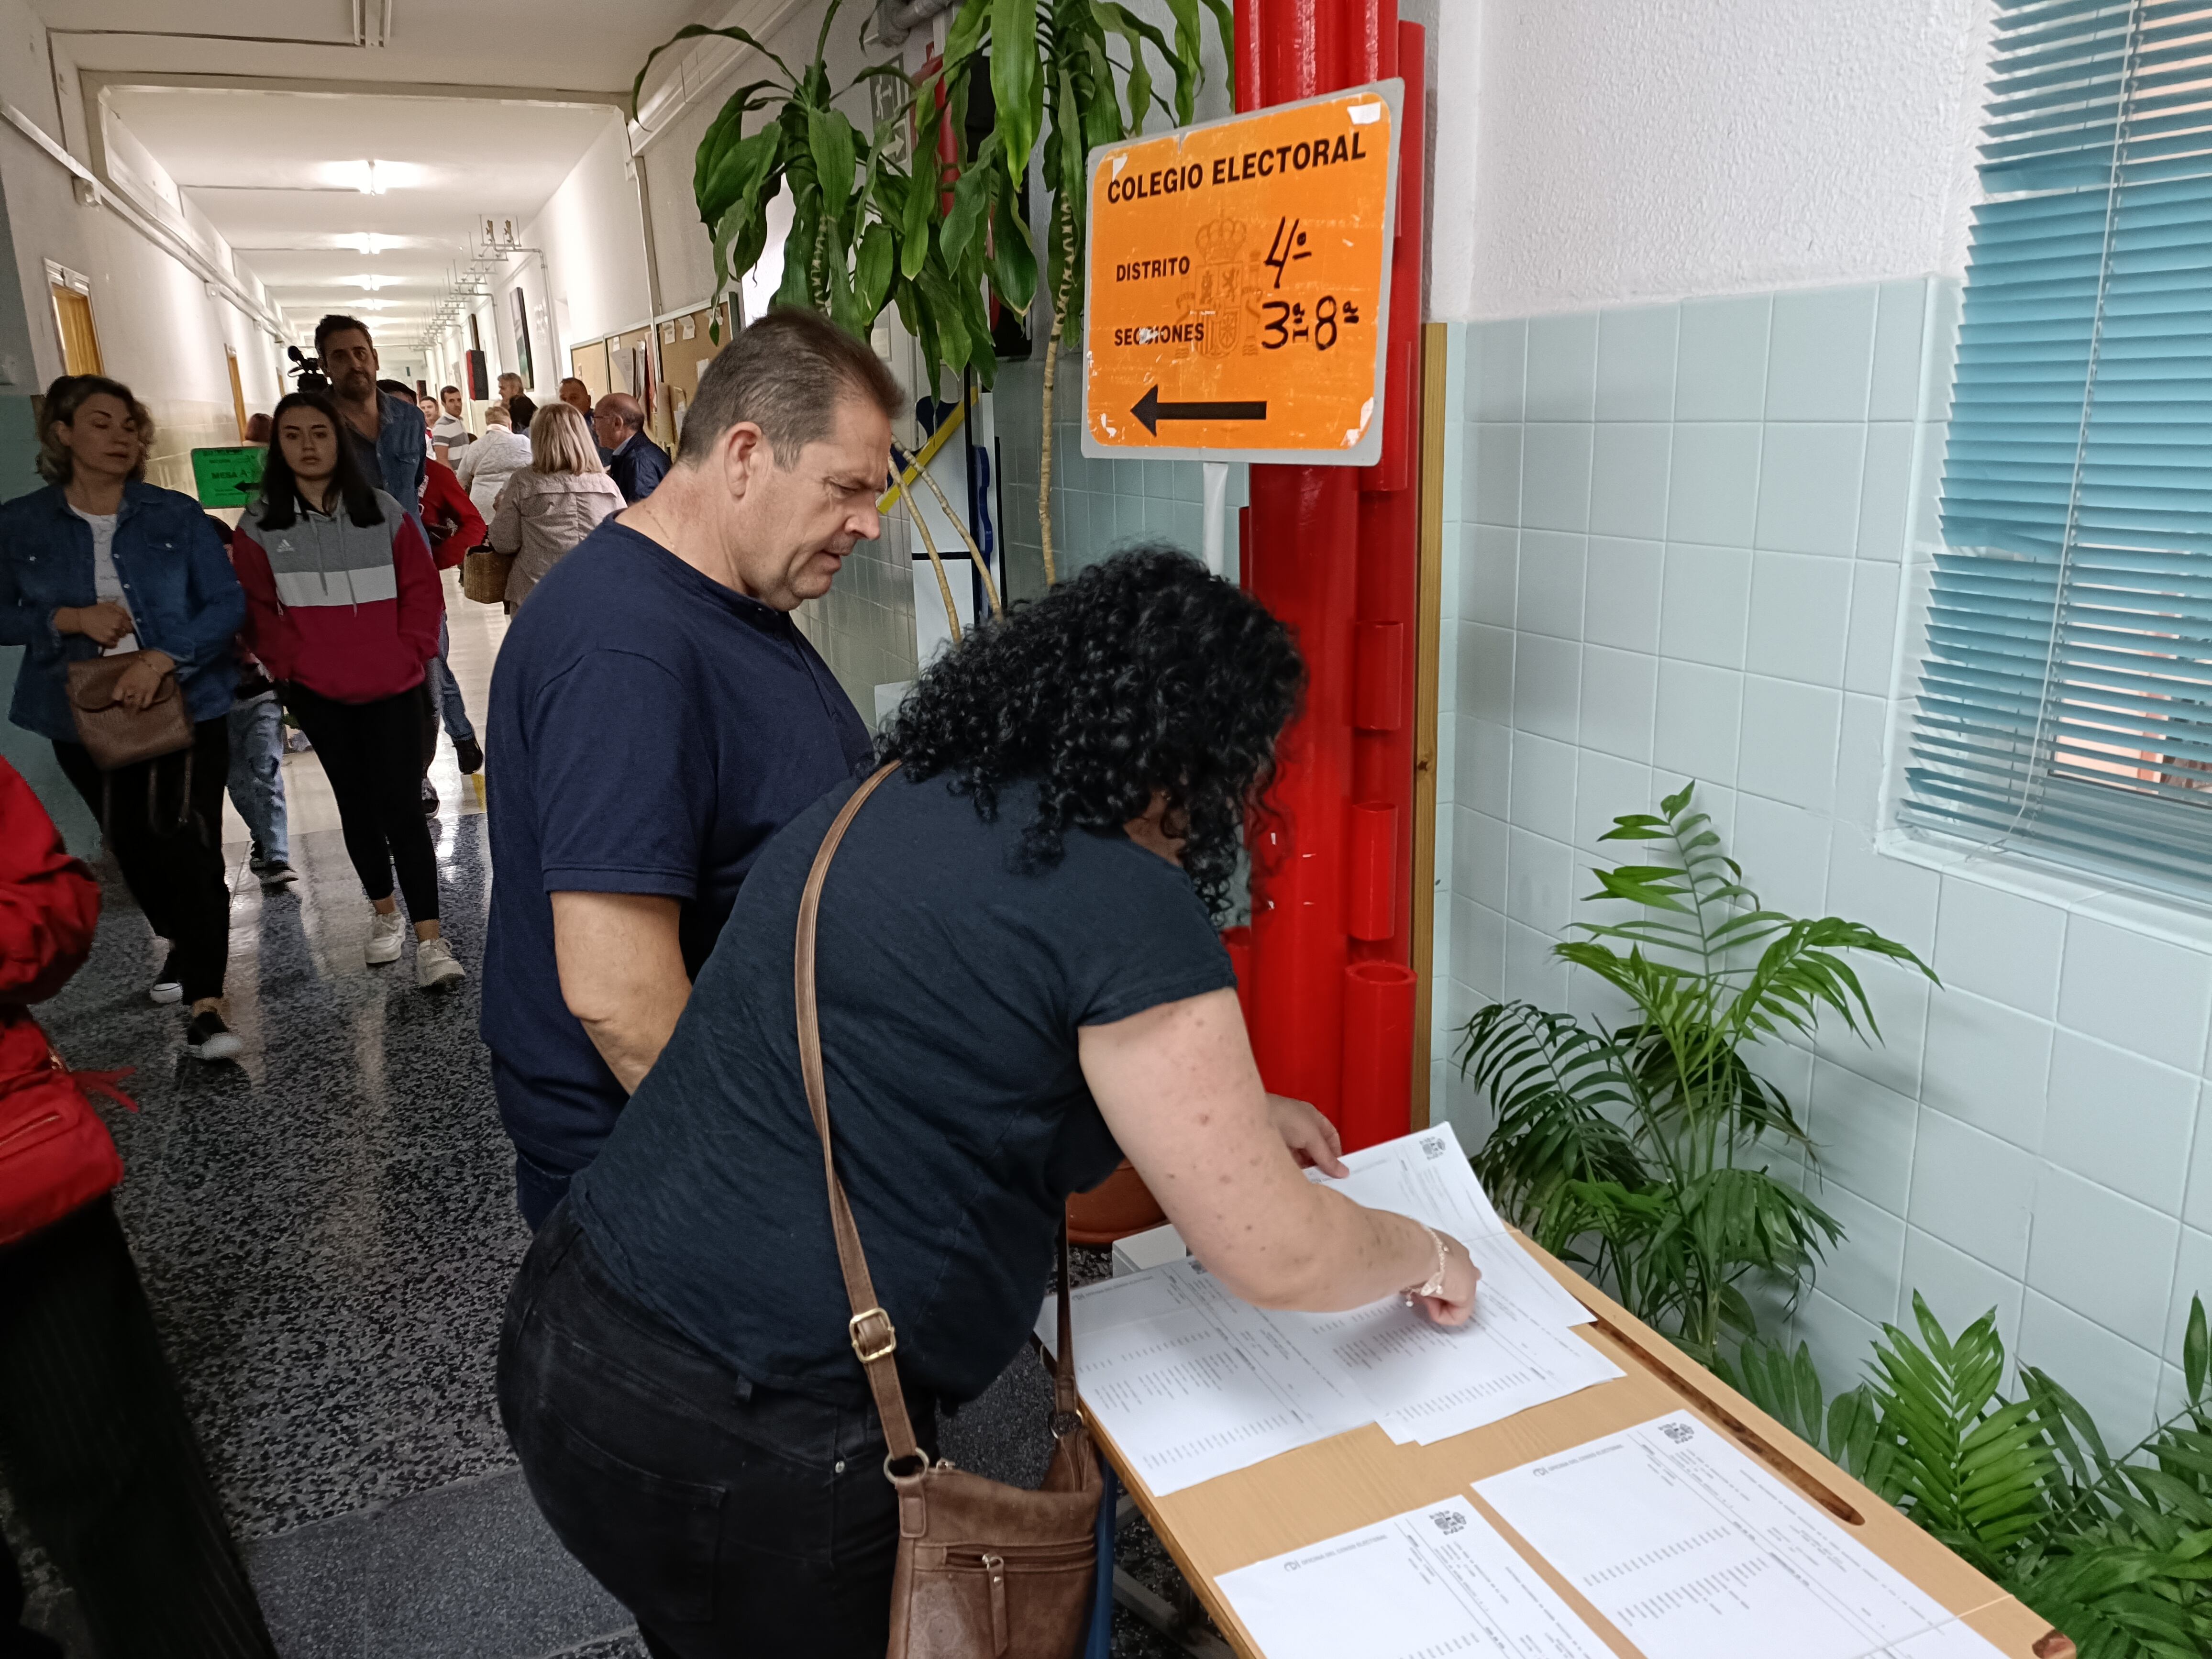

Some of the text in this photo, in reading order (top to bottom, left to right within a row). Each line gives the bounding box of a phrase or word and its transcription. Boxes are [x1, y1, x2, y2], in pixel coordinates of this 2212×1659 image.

[1107, 132, 1366, 204] COLEGIO ELECTORAL
[1116, 255, 1190, 282] DISTRITO
